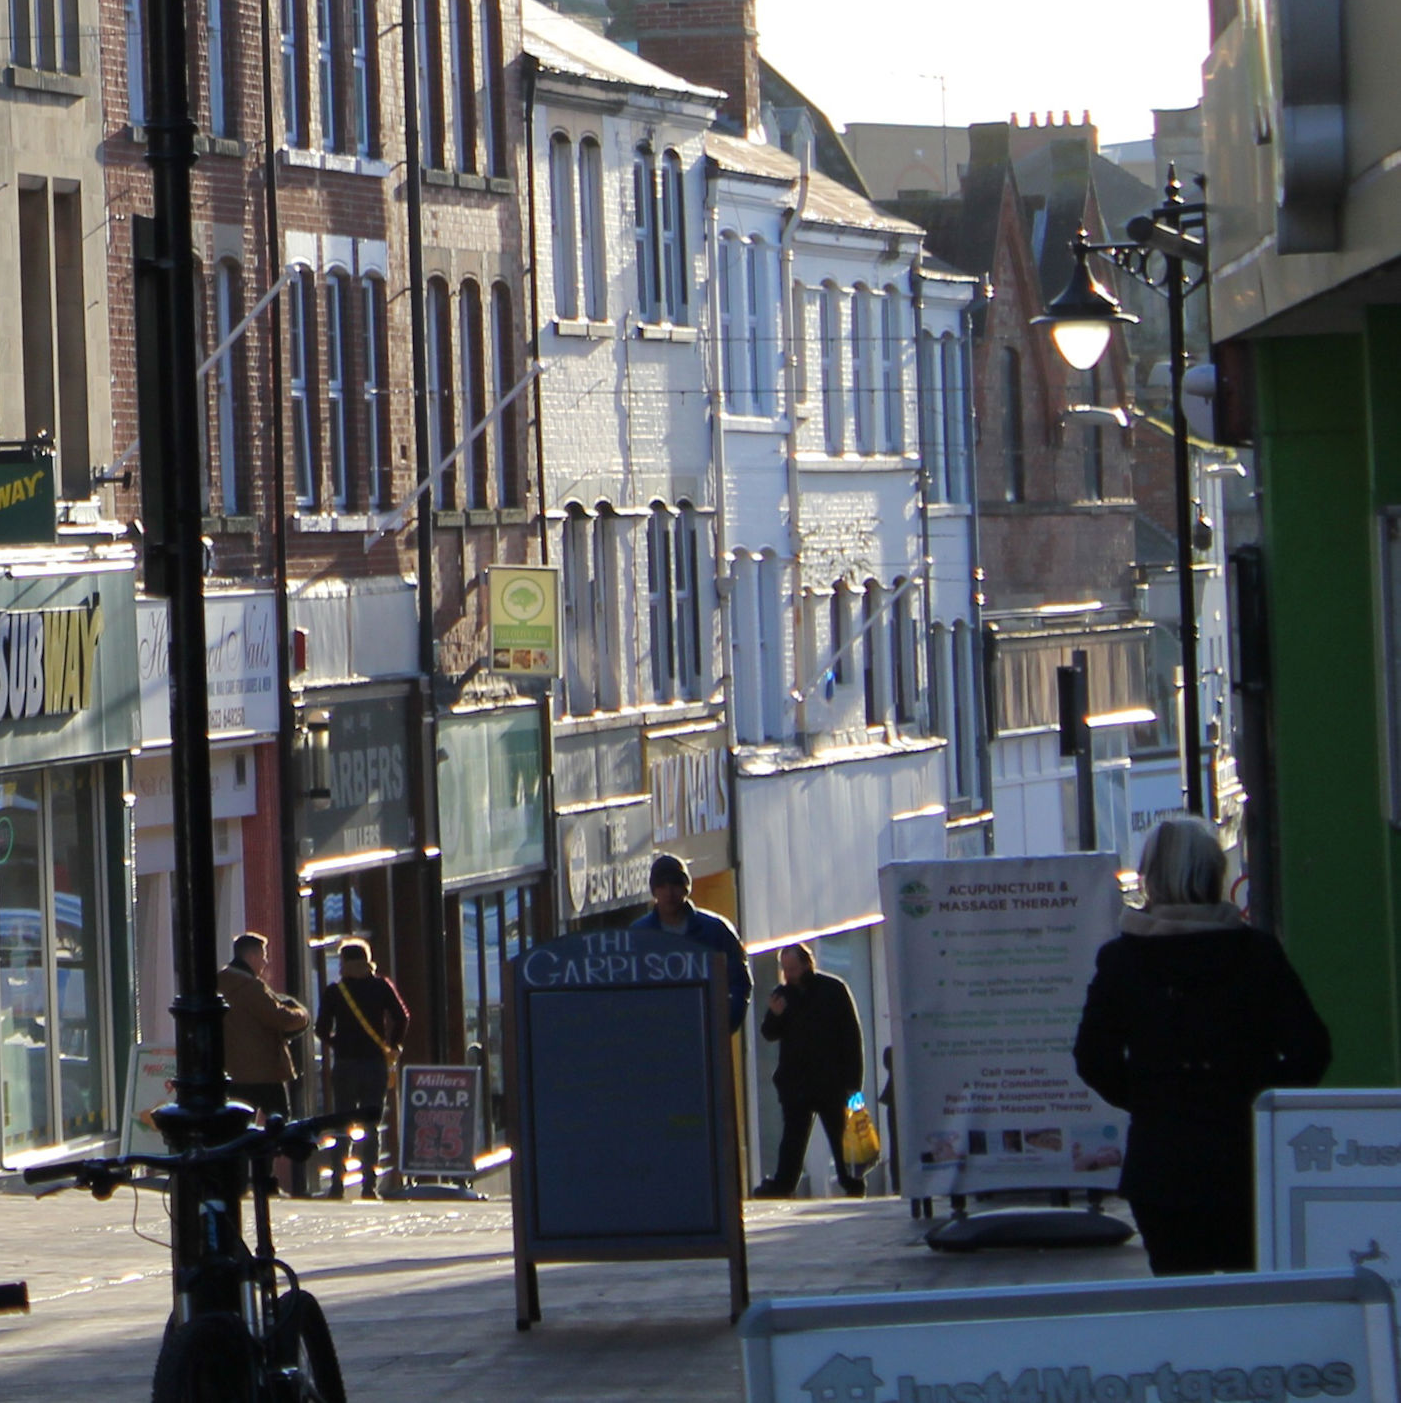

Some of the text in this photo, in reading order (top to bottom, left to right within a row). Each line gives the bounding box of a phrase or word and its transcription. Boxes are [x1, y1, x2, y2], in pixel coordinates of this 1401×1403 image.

[330, 744, 404, 809] ARBERS
[684, 745, 730, 837] NAILS
[342, 822, 382, 854] MILLERS
[948, 881, 1068, 896] ACUPUNCTURE &
[938, 897, 1079, 913] MASSAGE THERAPY
[415, 1073, 467, 1087] Millers
[974, 1080, 998, 1089] Free
[1001, 1078, 1069, 1089] Consultation
[410, 1089, 470, 1107] O.A.P.
[1000, 1103, 1046, 1115] Massage
[1049, 1102, 1093, 1114] Therapy
[413, 1125, 464, 1159] £5
